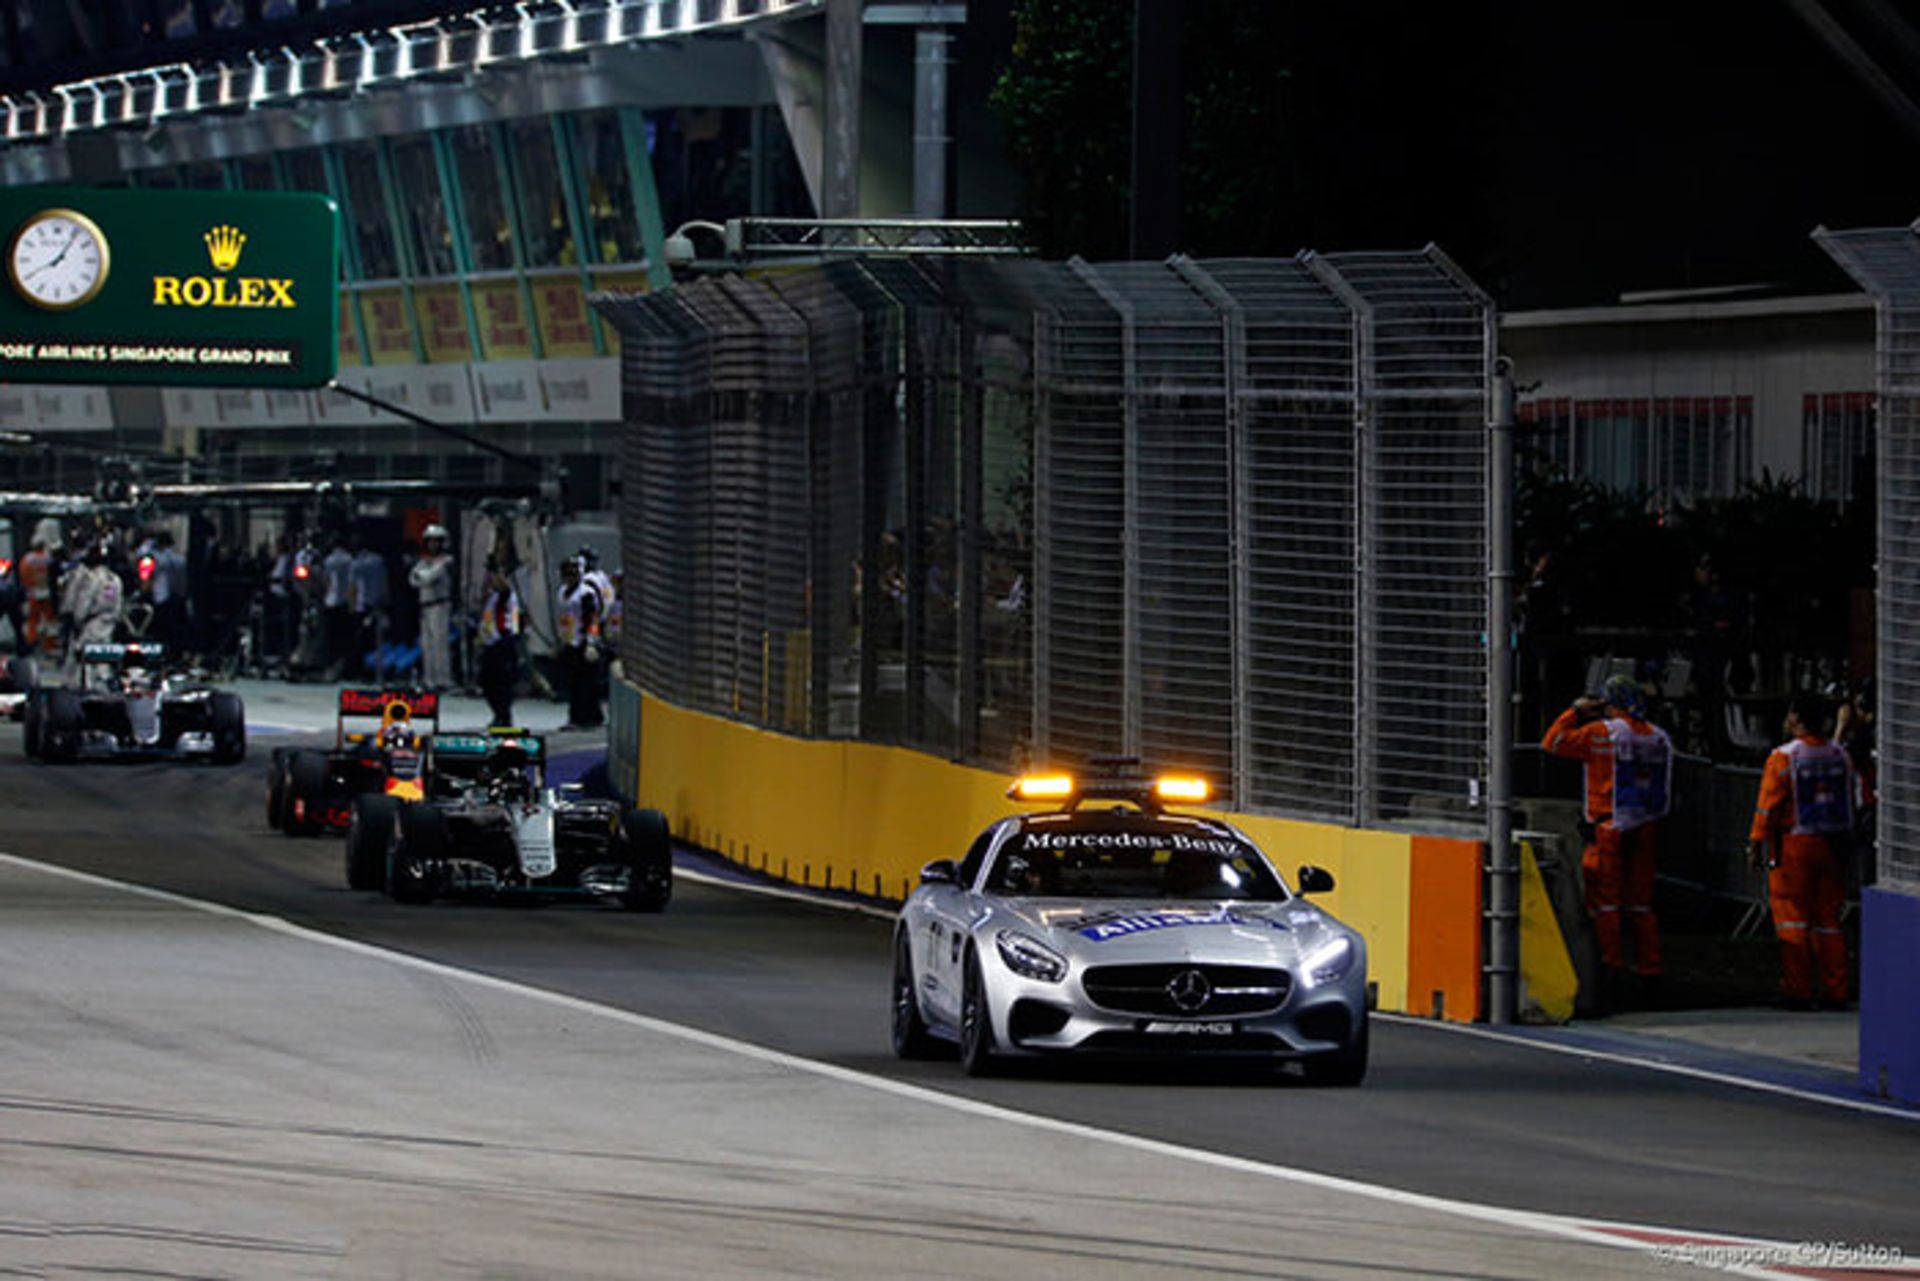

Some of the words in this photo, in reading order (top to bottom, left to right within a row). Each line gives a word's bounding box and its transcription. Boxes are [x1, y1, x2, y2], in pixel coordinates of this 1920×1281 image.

[153, 276, 296, 307] ROLEX
[38, 345, 107, 361] AIRLINES
[109, 347, 196, 362] SINGAPORE
[199, 348, 253, 364] GRAND
[255, 350, 291, 365] PRIX
[83, 642, 163, 654] PETRAS
[433, 735, 540, 751] PETRAS
[1023, 833, 1240, 855] Mercedes-Benz
